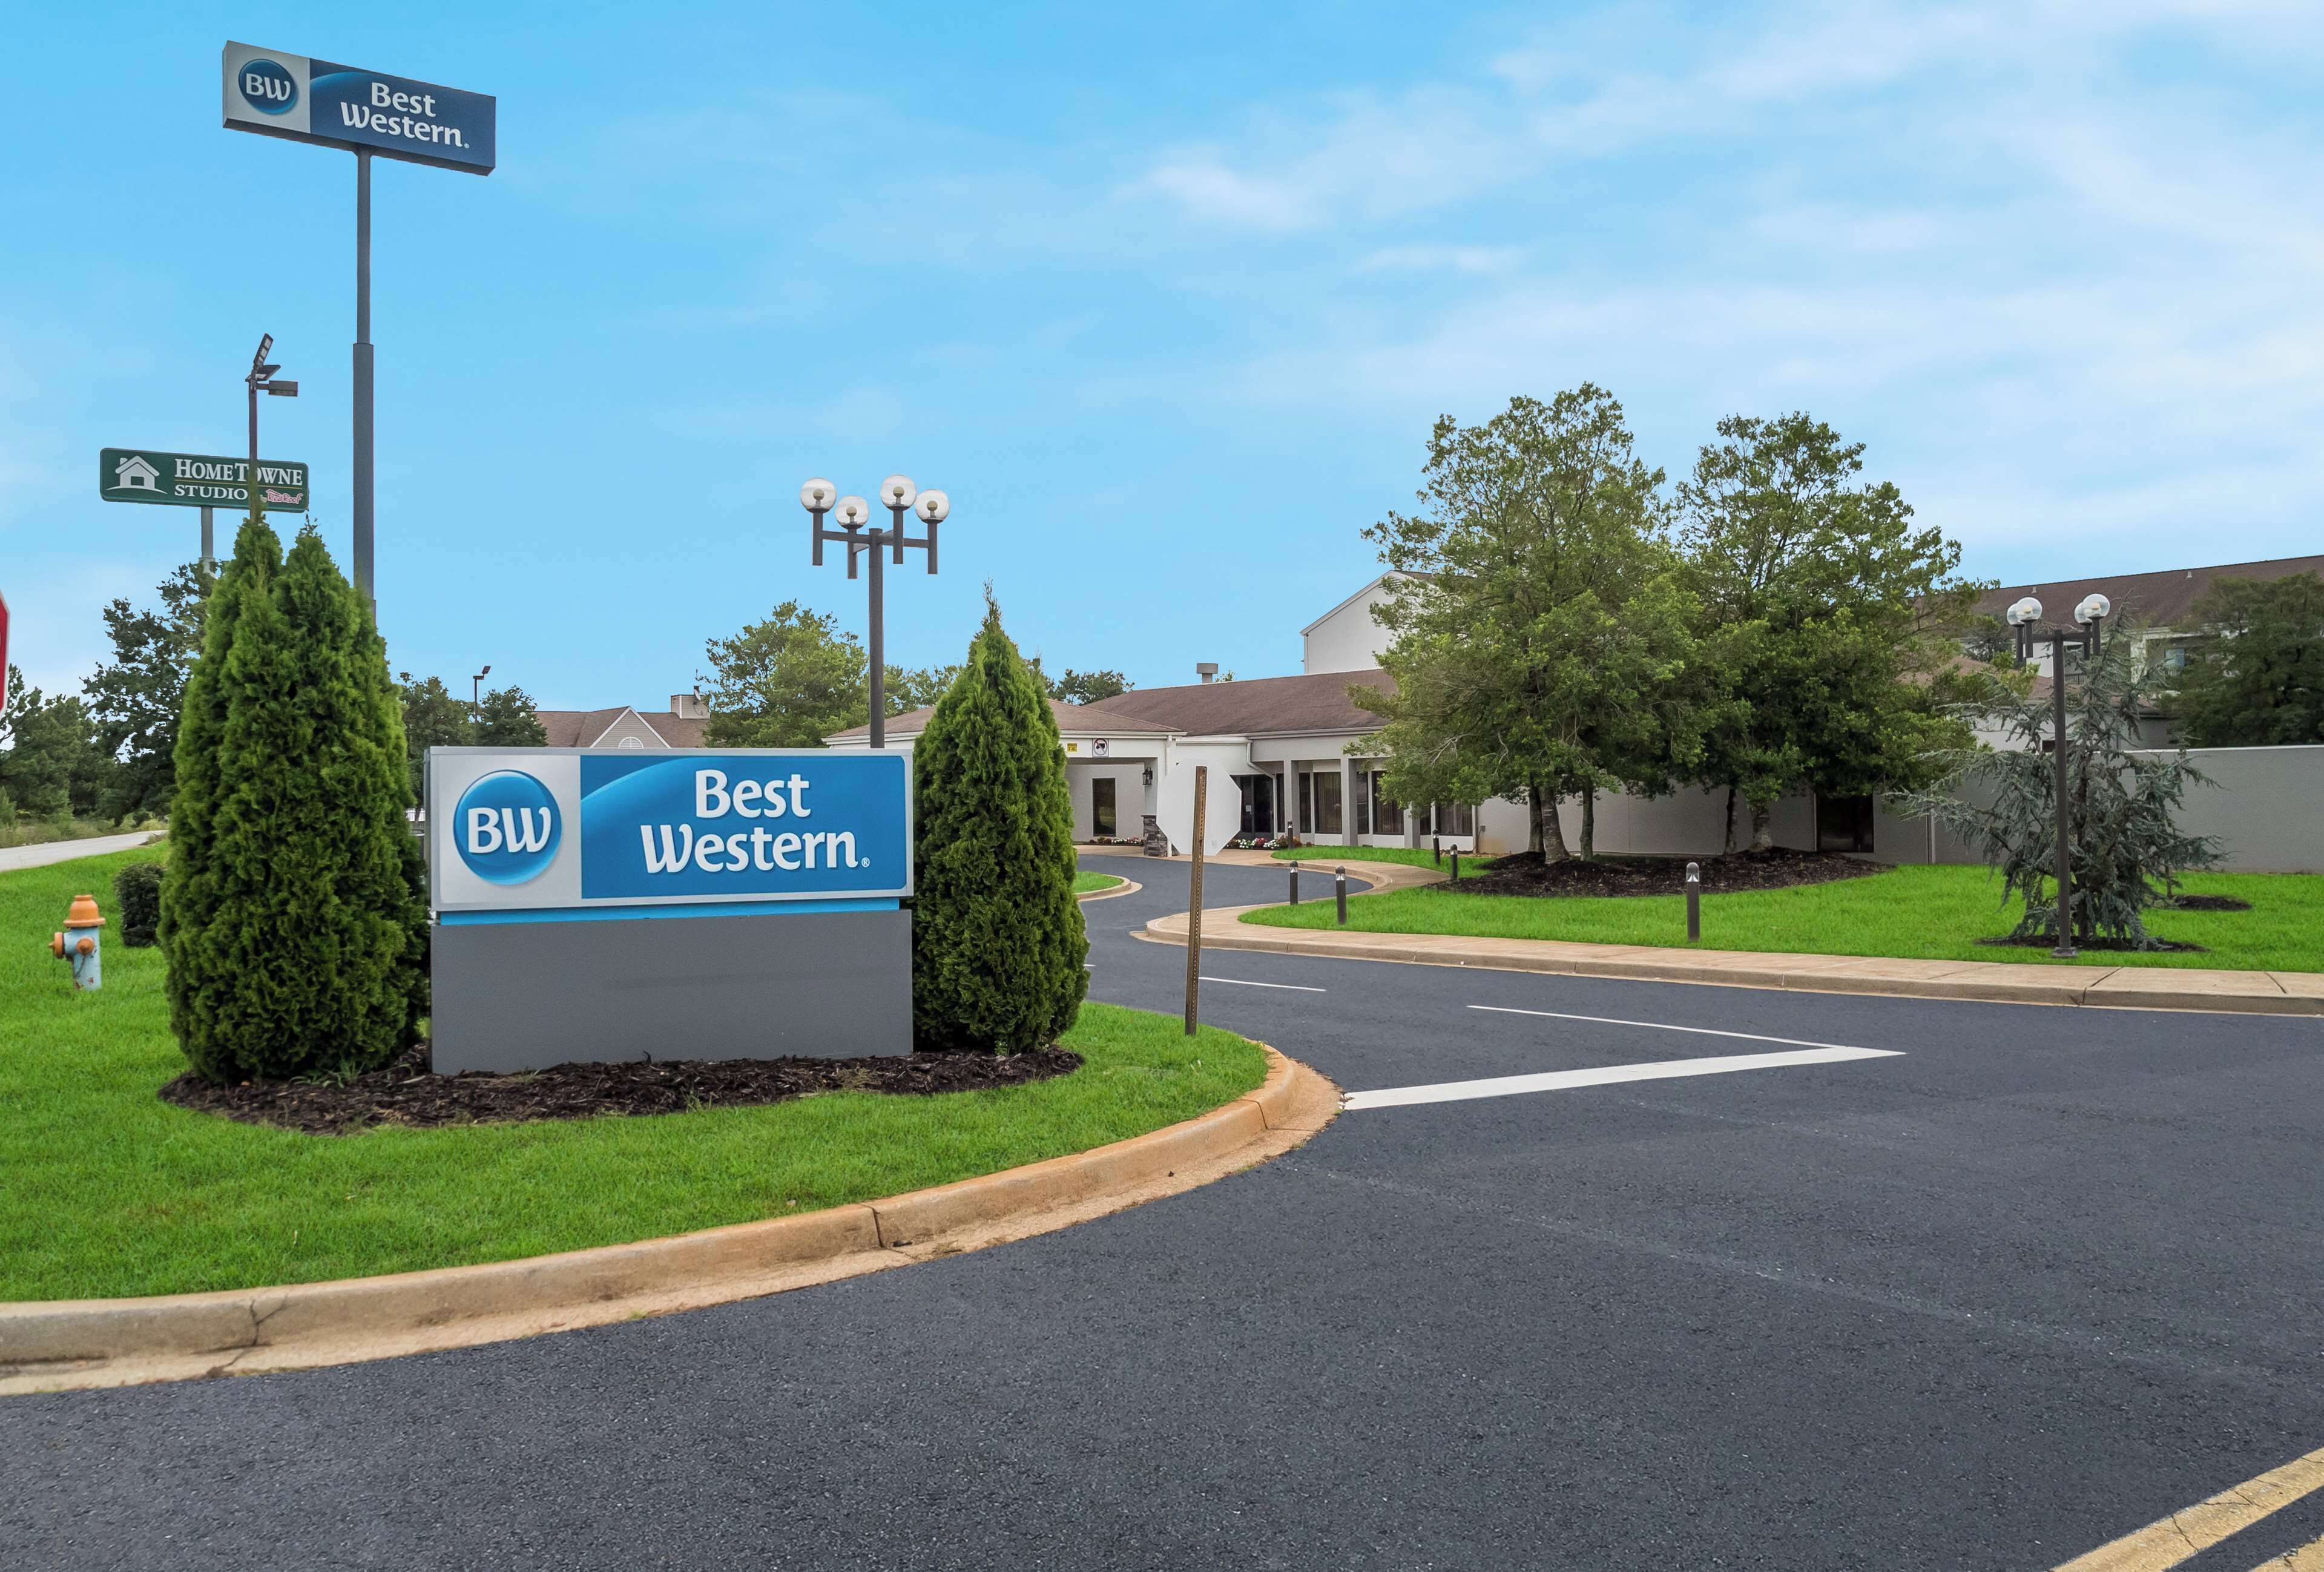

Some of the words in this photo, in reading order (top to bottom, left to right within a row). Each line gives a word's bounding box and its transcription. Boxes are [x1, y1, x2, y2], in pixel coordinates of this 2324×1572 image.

[246, 73, 291, 101] BW
[371, 82, 436, 117] Best
[174, 484, 250, 500] STUDIO
[695, 769, 811, 818] Best
[467, 807, 551, 854] BW
